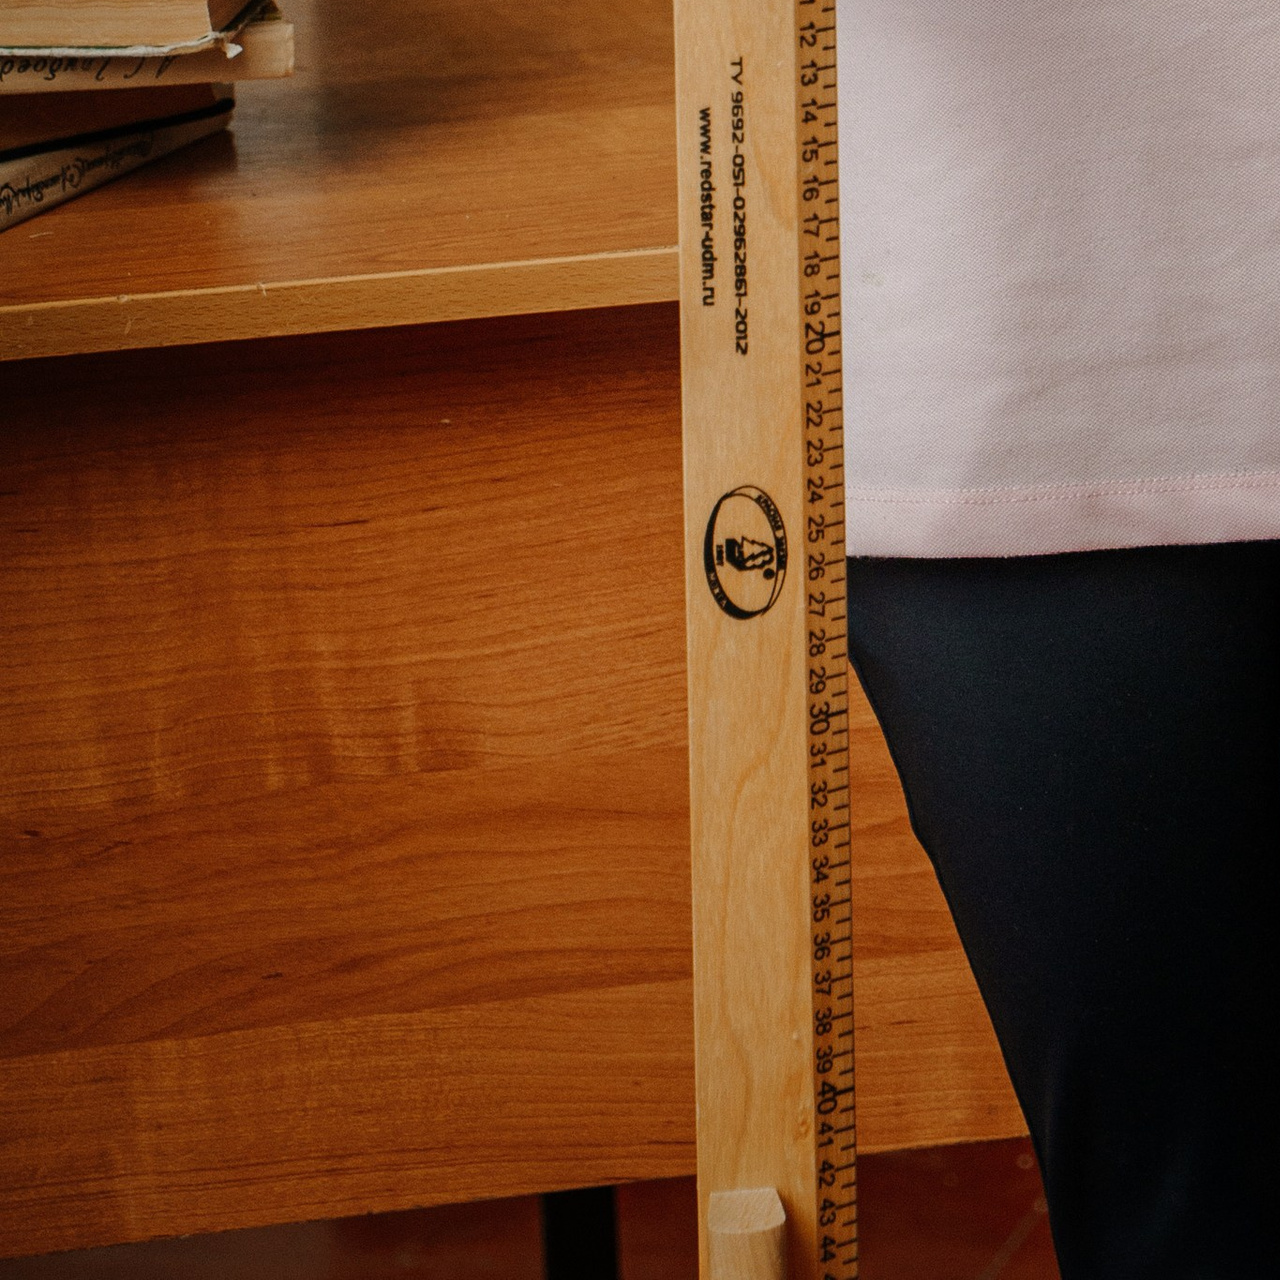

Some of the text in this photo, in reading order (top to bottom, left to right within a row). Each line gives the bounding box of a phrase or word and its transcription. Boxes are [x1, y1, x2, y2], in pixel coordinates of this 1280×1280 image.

[799, 21, 817, 48] 12
[801, 59, 818, 86] 13
[801, 98, 818, 124] 14
[802, 136, 819, 163] 15
[802, 175, 819, 202] 16
[699, 107, 716, 307] www.redstar-udm.ru
[803, 213, 819, 238] 17
[803, 251, 820, 278] 18
[804, 290, 821, 316] 19
[805, 321, 825, 355] 20
[805, 362, 822, 388] 21
[806, 401, 823, 430] 22
[807, 438, 824, 467] 23
[807, 476, 824, 505] 24
[808, 514, 825, 543] 25
[808, 553, 825, 581] 26
[808, 592, 825, 617] 27
[809, 629, 826, 657] 28
[809, 666, 826, 695] 29
[809, 701, 830, 736] 30
[810, 742, 827, 769] 31
[811, 781, 828, 810] 32
[811, 818, 829, 848] 33
[812, 856, 829, 884] 34
[813, 894, 830, 923] 35
[814, 932, 831, 961] 36
[814, 970, 832, 997] 37
[815, 1007, 832, 1036] 38
[816, 1045, 833, 1075] 39
[817, 1080, 837, 1115] 40
[818, 1121, 835, 1148] 41
[819, 1159, 836, 1189] 42
[820, 1198, 837, 1227] 43
[820, 1236, 837, 1264] 44
